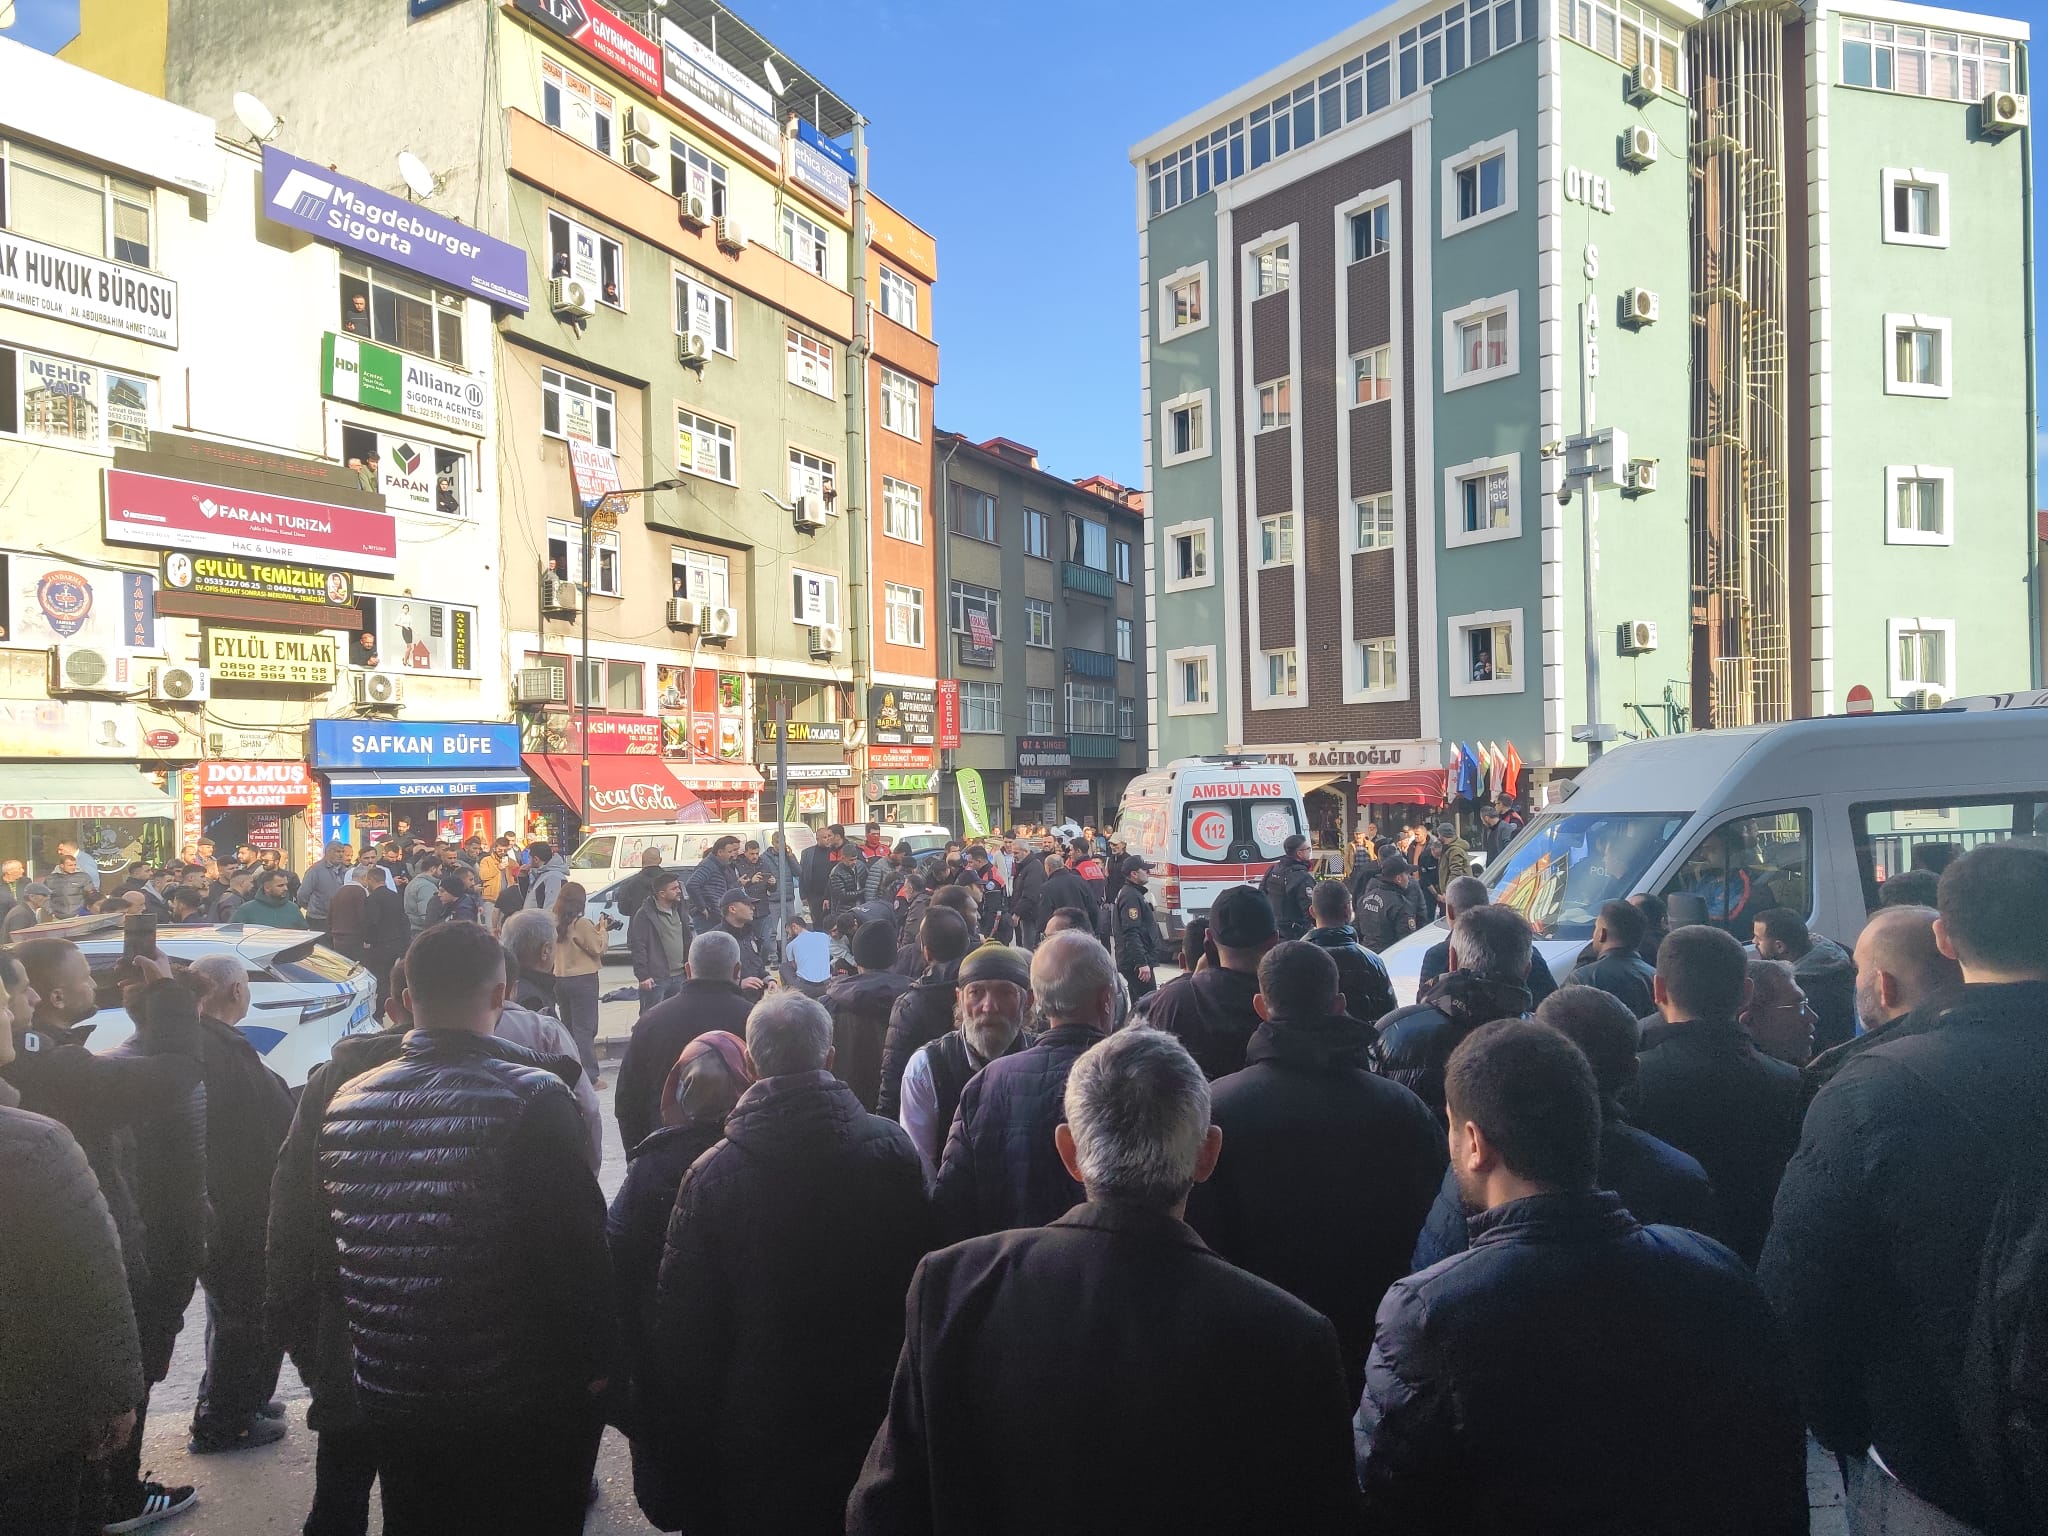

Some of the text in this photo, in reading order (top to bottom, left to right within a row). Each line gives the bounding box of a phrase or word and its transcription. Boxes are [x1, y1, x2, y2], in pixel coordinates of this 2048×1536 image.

[795, 147, 821, 171] ethica
[1564, 165, 1615, 215] OTEL
[327, 208, 412, 255] Sigorta
[331, 187, 481, 259] Magdeburger
[26, 250, 92, 299] HUKUK
[98, 268, 172, 320] BÜROSU
[17, 291, 40, 307] AHMET
[126, 320, 147, 335] AHMET
[30, 359, 91, 386] NEHİR
[335, 357, 358, 373] HDI
[41, 377, 86, 400] YAPI
[407, 367, 462, 398] Allianz
[385, 475, 429, 494] FARAN
[220, 505, 273, 525] FARAN
[232, 541, 293, 556] HAC & UMRE
[194, 558, 325, 589] EYLÜL TEMİZLİK
[204, 578, 224, 586] 0535
[225, 579, 239, 587] 227
[240, 581, 250, 589] 06
[250, 582, 261, 590] 25
[273, 584, 291, 593] 0462
[292, 586, 306, 594] 999
[133, 576, 144, 645] JANVAK
[214, 635, 332, 663] EYLÜL EMLAK
[219, 662, 327, 674] 0850 227 90 58
[219, 670, 327, 682] 0462 999 11 52
[574, 720, 658, 735] TKSİM MARKET
[352, 733, 492, 754] SAFKAN BÜFE
[871, 754, 882, 762] KIZ
[1263, 745, 1402, 766] TEL SAĞIROĞLU
[207, 764, 306, 784] DOLMUŞ
[885, 774, 928, 790] BLACK
[203, 785, 308, 797] ÇAY KAHVALTI
[399, 783, 477, 795] SAFKAN BÜFE
[1192, 782, 1281, 799] AMBULANS
[69, 804, 137, 818] MİRAC
[227, 796, 286, 806] SALONU
[1204, 823, 1226, 840] 112
